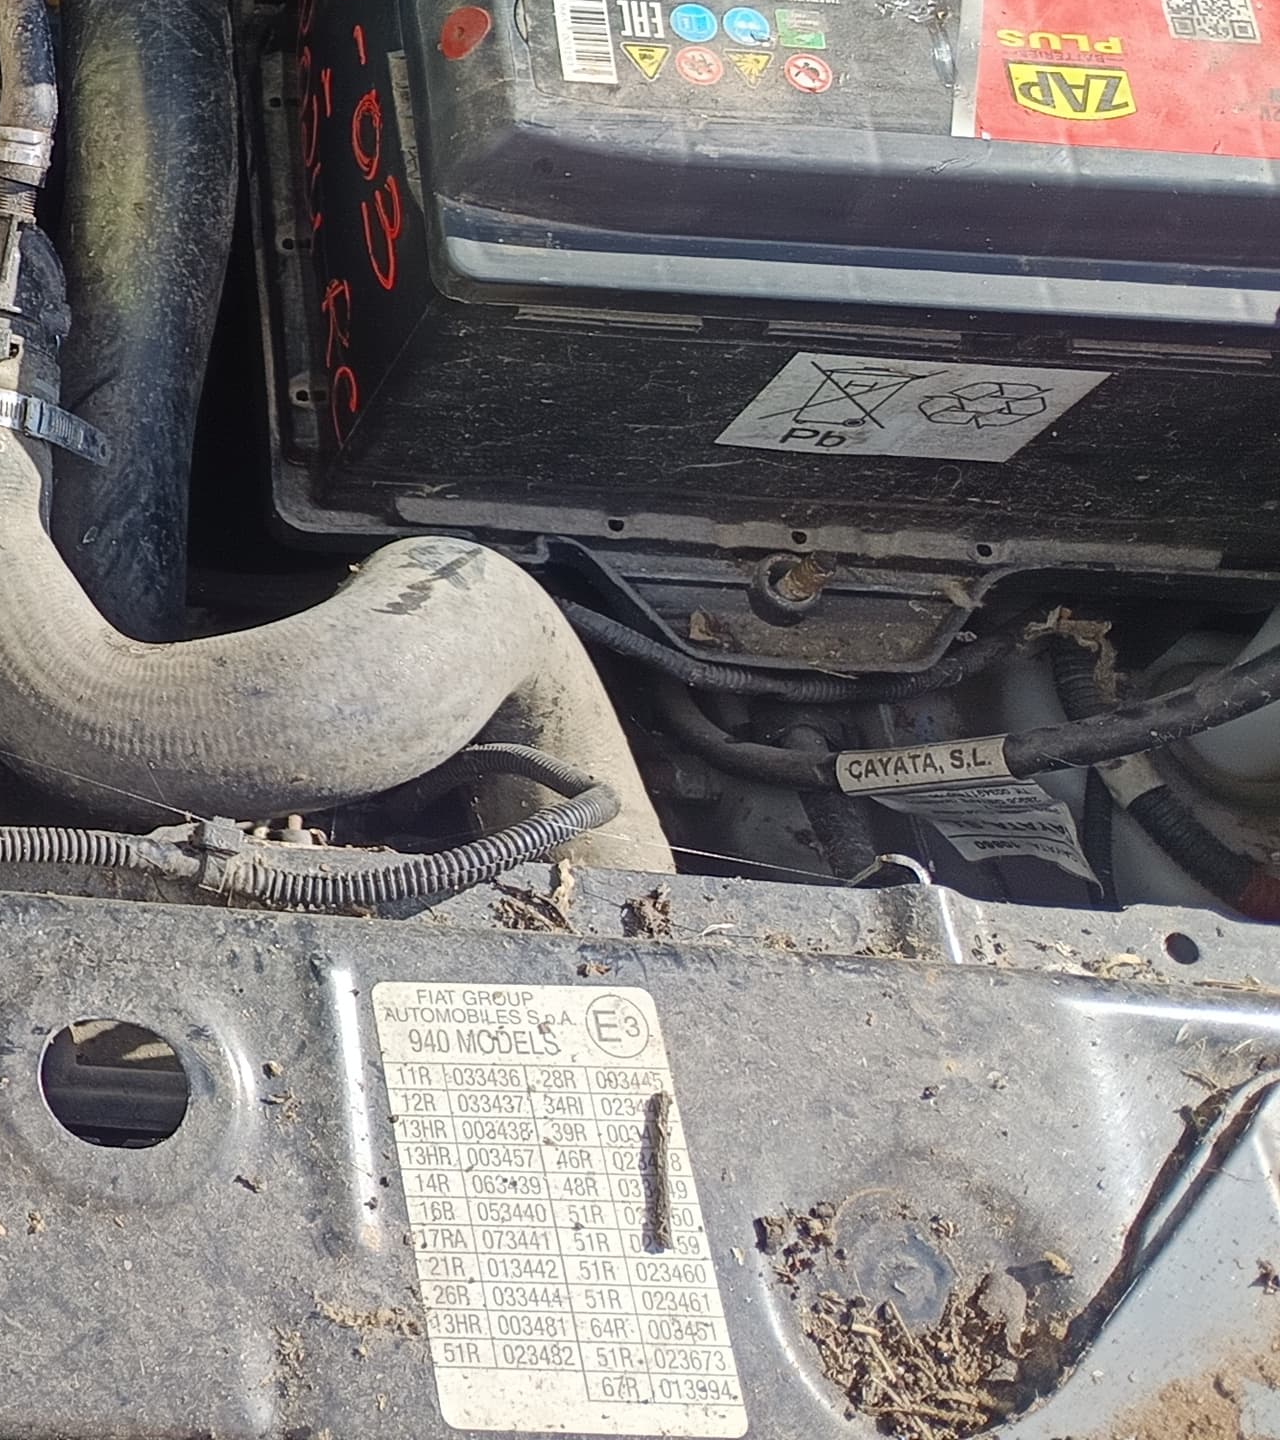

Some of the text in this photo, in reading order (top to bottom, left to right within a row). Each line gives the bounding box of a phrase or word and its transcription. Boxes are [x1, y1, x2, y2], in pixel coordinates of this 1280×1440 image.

[996, 29, 1124, 54] PLUS
[1018, 70, 1129, 114] ZAP
[779, 428, 847, 448] Pb
[416, 989, 533, 1007] FIAT GROUP
[384, 1007, 521, 1025] AUTOMOBILES
[408, 1028, 561, 1056] 940 MODELS
[397, 1066, 664, 1090] 11R 033436 28R 003445
[401, 1093, 584, 1115] 12R 033437 34RI
[399, 1119, 448, 1139] 13HR
[462, 1120, 531, 1140] 003438
[551, 1122, 588, 1143] 39R
[403, 1146, 682, 1172] 13HR 003457 46R 02348
[414, 1174, 450, 1194] 14R
[471, 1175, 541, 1195] 063439
[563, 1177, 599, 1197] 48R
[420, 1201, 605, 1225] 16R 053440 51R
[418, 1228, 468, 1249] 17RA
[482, 1230, 552, 1251] 073441
[574, 1232, 610, 1253] 51R
[429, 1258, 707, 1284] 21R 013442 51R 023460
[433, 1285, 712, 1312] 26R 033444 51R 023461
[432, 1314, 718, 1343] 13HR 003481 64R 003451
[443, 1342, 727, 1371] 51R 023482 51R 023673
[602, 1376, 732, 1401] 67R 013994
